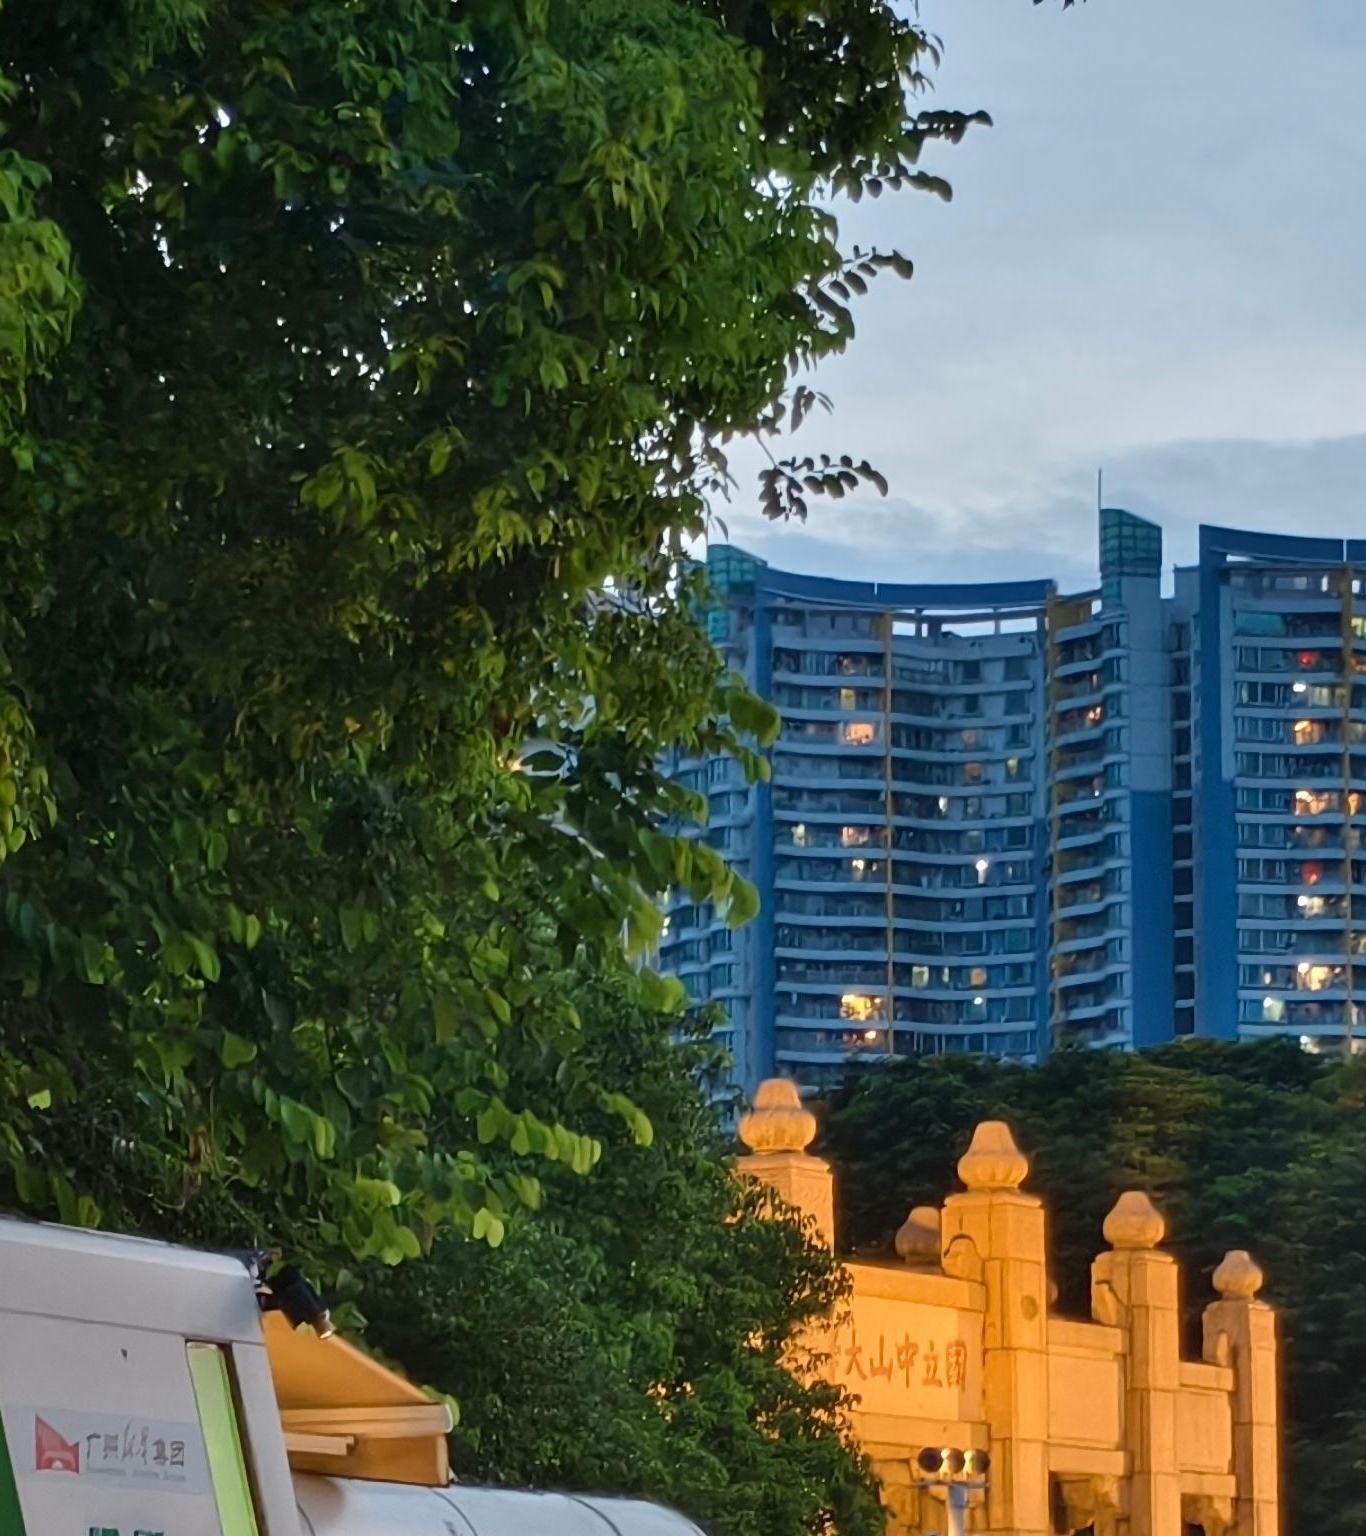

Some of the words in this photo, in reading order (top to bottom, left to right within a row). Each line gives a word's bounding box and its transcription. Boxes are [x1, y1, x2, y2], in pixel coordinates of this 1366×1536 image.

[829, 1325, 968, 1392] 國立中山大
